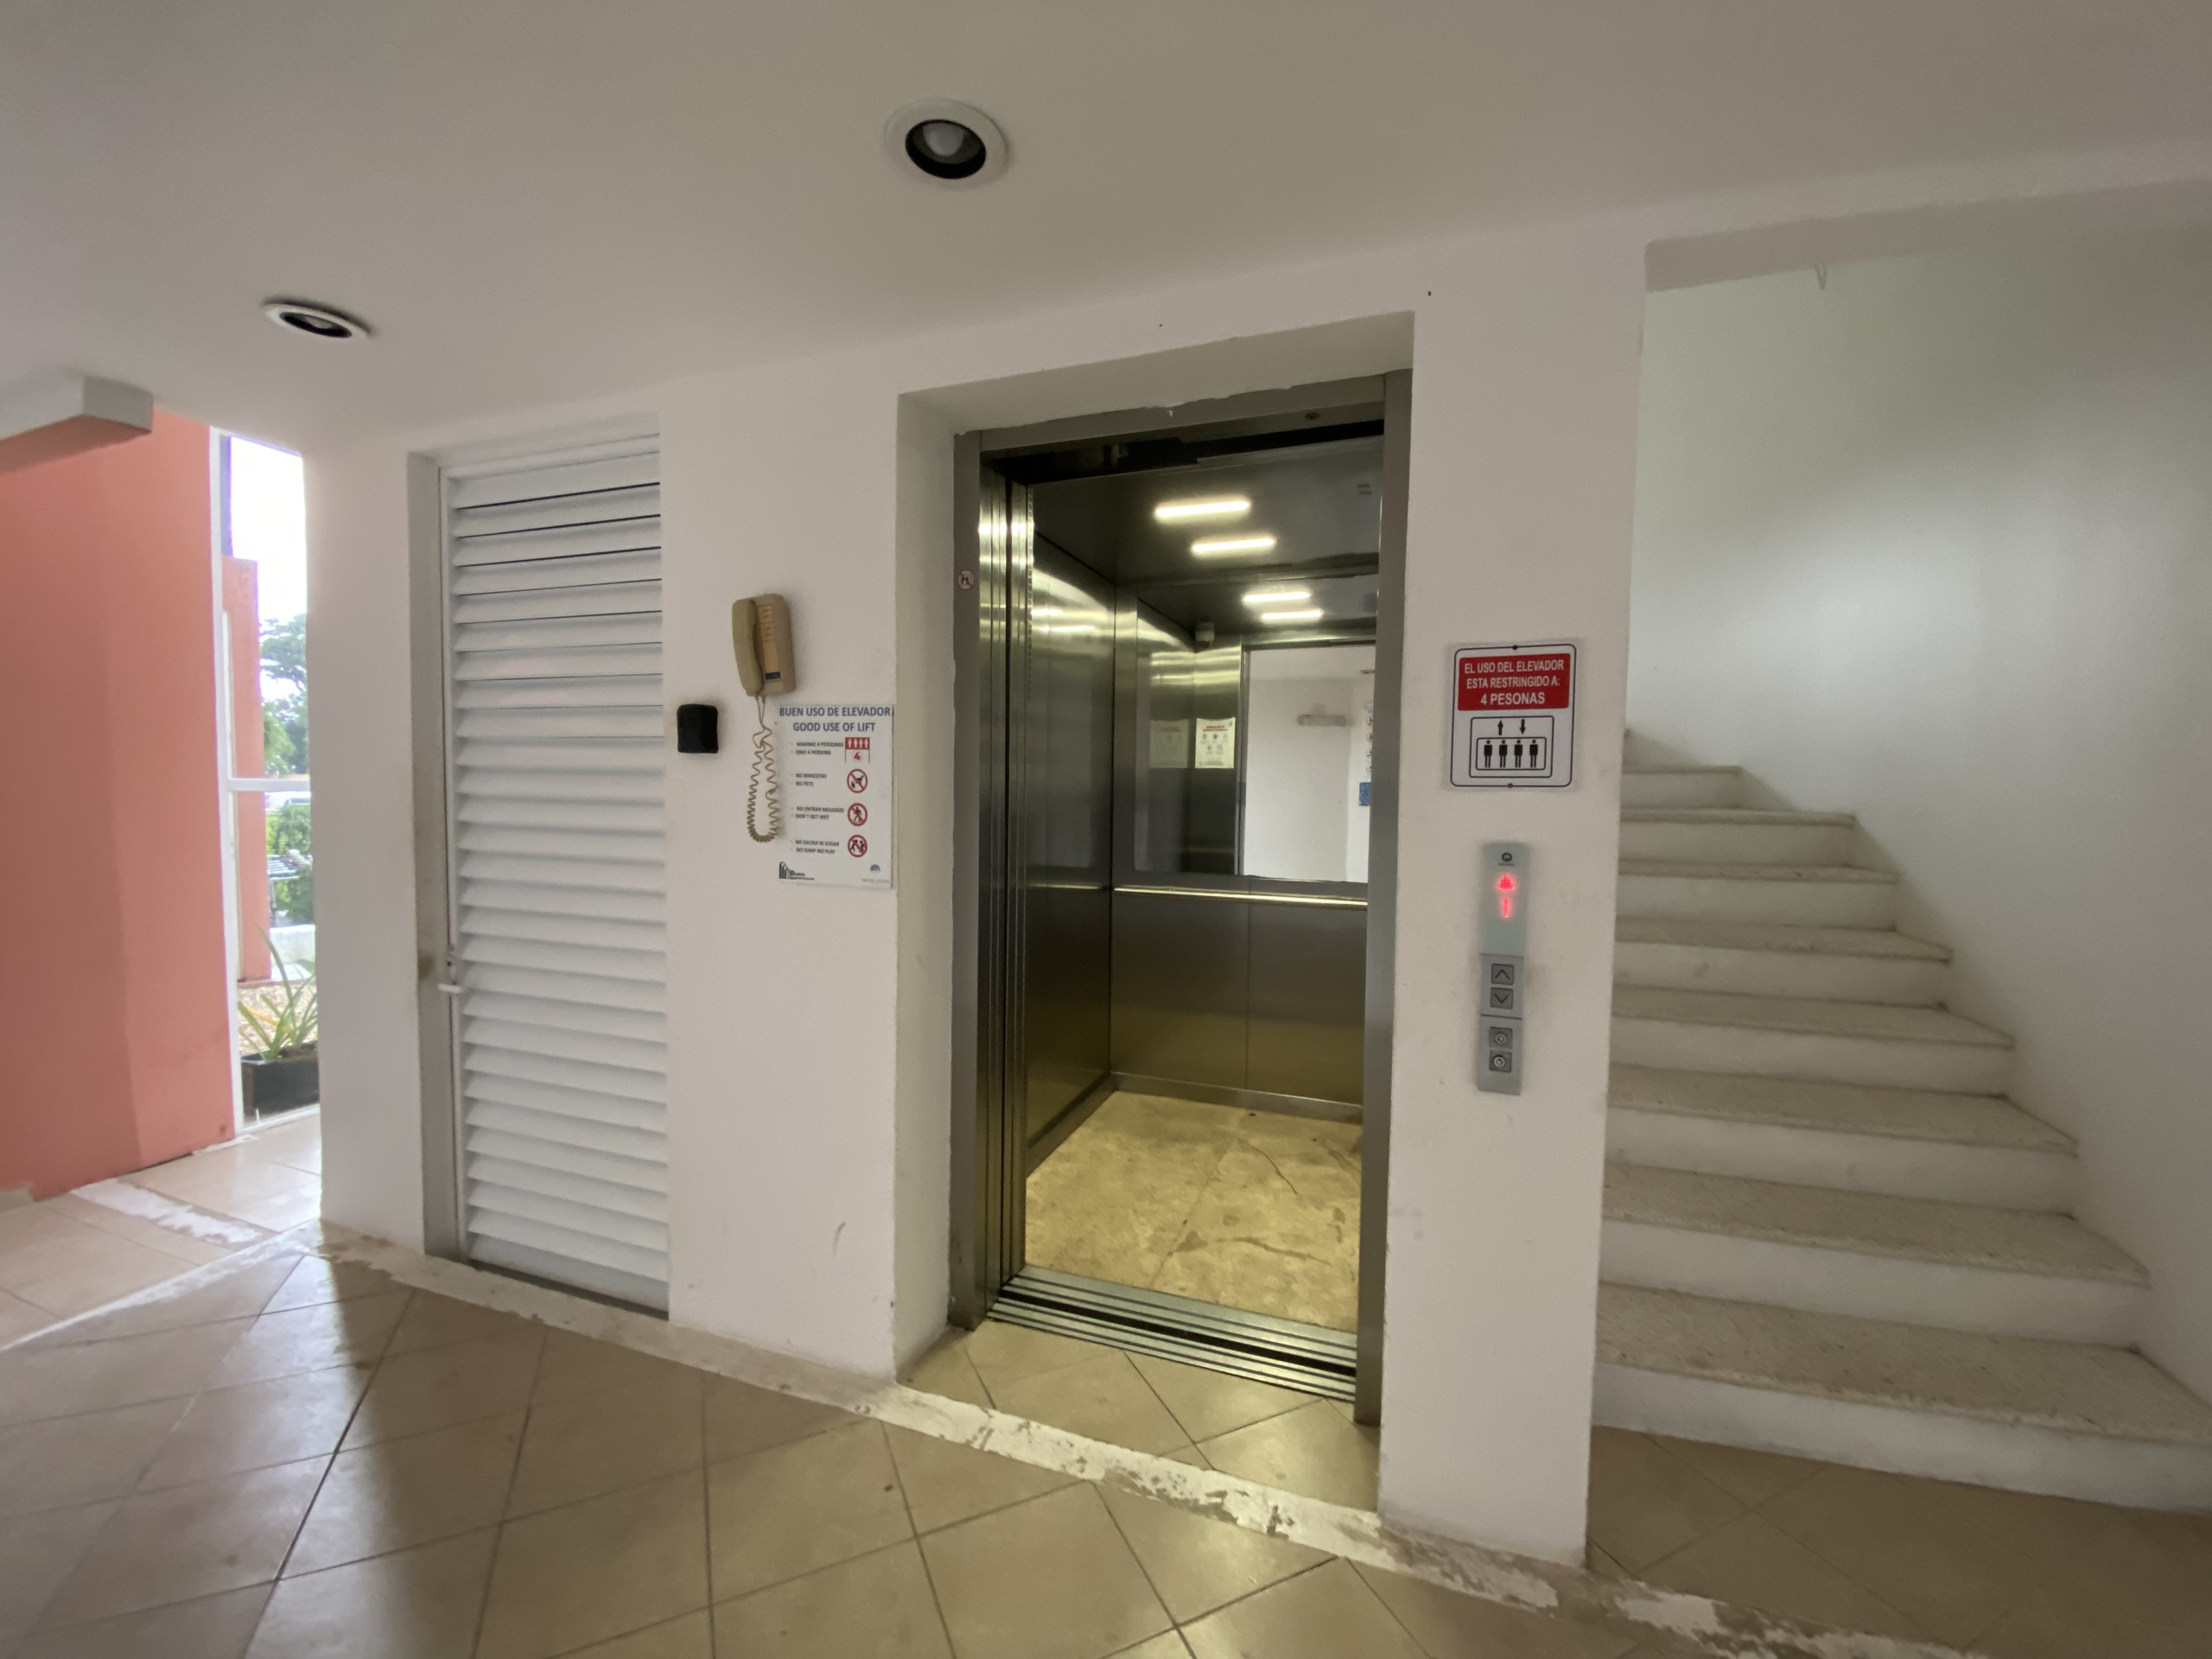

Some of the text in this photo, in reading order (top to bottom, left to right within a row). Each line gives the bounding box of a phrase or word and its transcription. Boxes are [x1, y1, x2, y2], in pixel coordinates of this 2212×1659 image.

[1465, 659, 1565, 674] EL USO DEL ELEVADOR
[1466, 677, 1488, 689] ESTA
[1491, 676, 1549, 688] RESTRINGIDO
[1480, 692, 1545, 705] 4 PESONAS
[779, 707, 891, 716] BUEN USO DE ELEVADOR
[792, 722, 876, 732] GOOD USE OF LIFT
